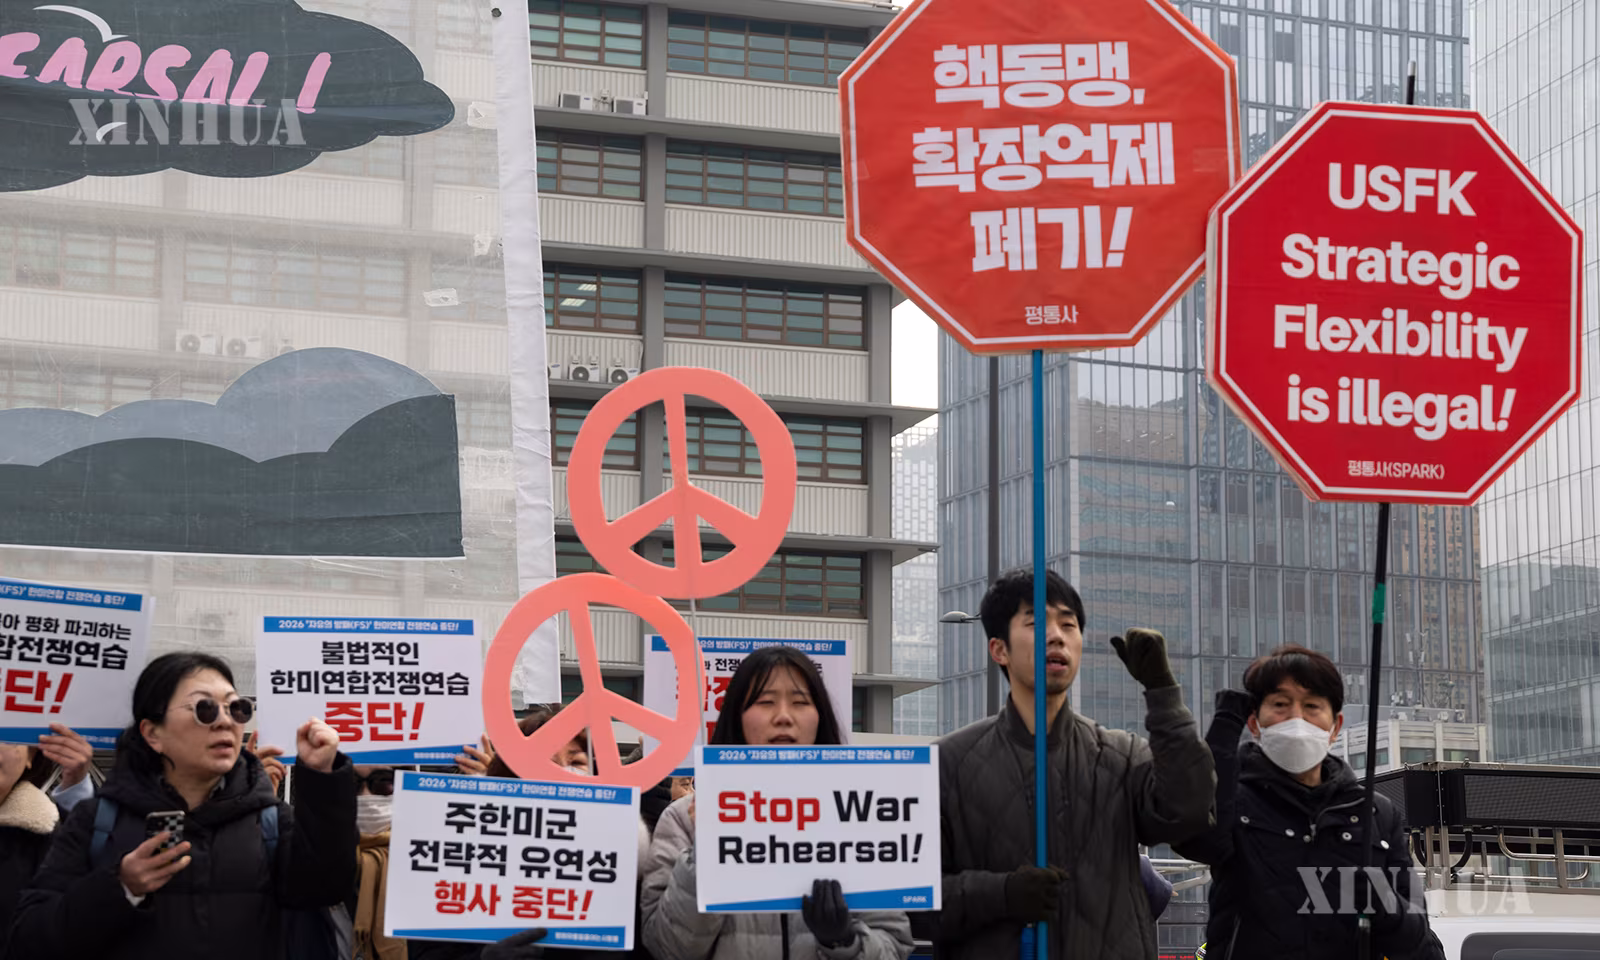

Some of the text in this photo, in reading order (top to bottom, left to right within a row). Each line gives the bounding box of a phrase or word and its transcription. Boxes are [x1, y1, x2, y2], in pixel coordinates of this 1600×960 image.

[933, 41, 1146, 108] 핵동맹,
[912, 122, 1175, 192] 확장억제
[1328, 162, 1478, 216] USFK
[970, 205, 1133, 272] 폐기!
[1281, 233, 1520, 300] Strategic
[1024, 305, 1079, 326] 평통사
[1273, 303, 1528, 372] Flexibility
[1287, 373, 1517, 441] is illegal!
[0, 612, 131, 641] 아 평화 파괴하는
[278, 620, 305, 628] 2026
[321, 641, 419, 665] 불법적인
[0, 667, 73, 714] 단!
[270, 670, 469, 695] 한미연합전쟁연습
[324, 702, 425, 742] 중단!
[719, 750, 747, 760] 2026
[418, 777, 446, 788] 2026
[444, 802, 577, 841] 주한미군
[718, 790, 919, 831] Stop War
[409, 839, 618, 883] 전략적 유연성
[718, 833, 923, 864] Rehearsal!
[434, 880, 594, 920] 행사 중단!
